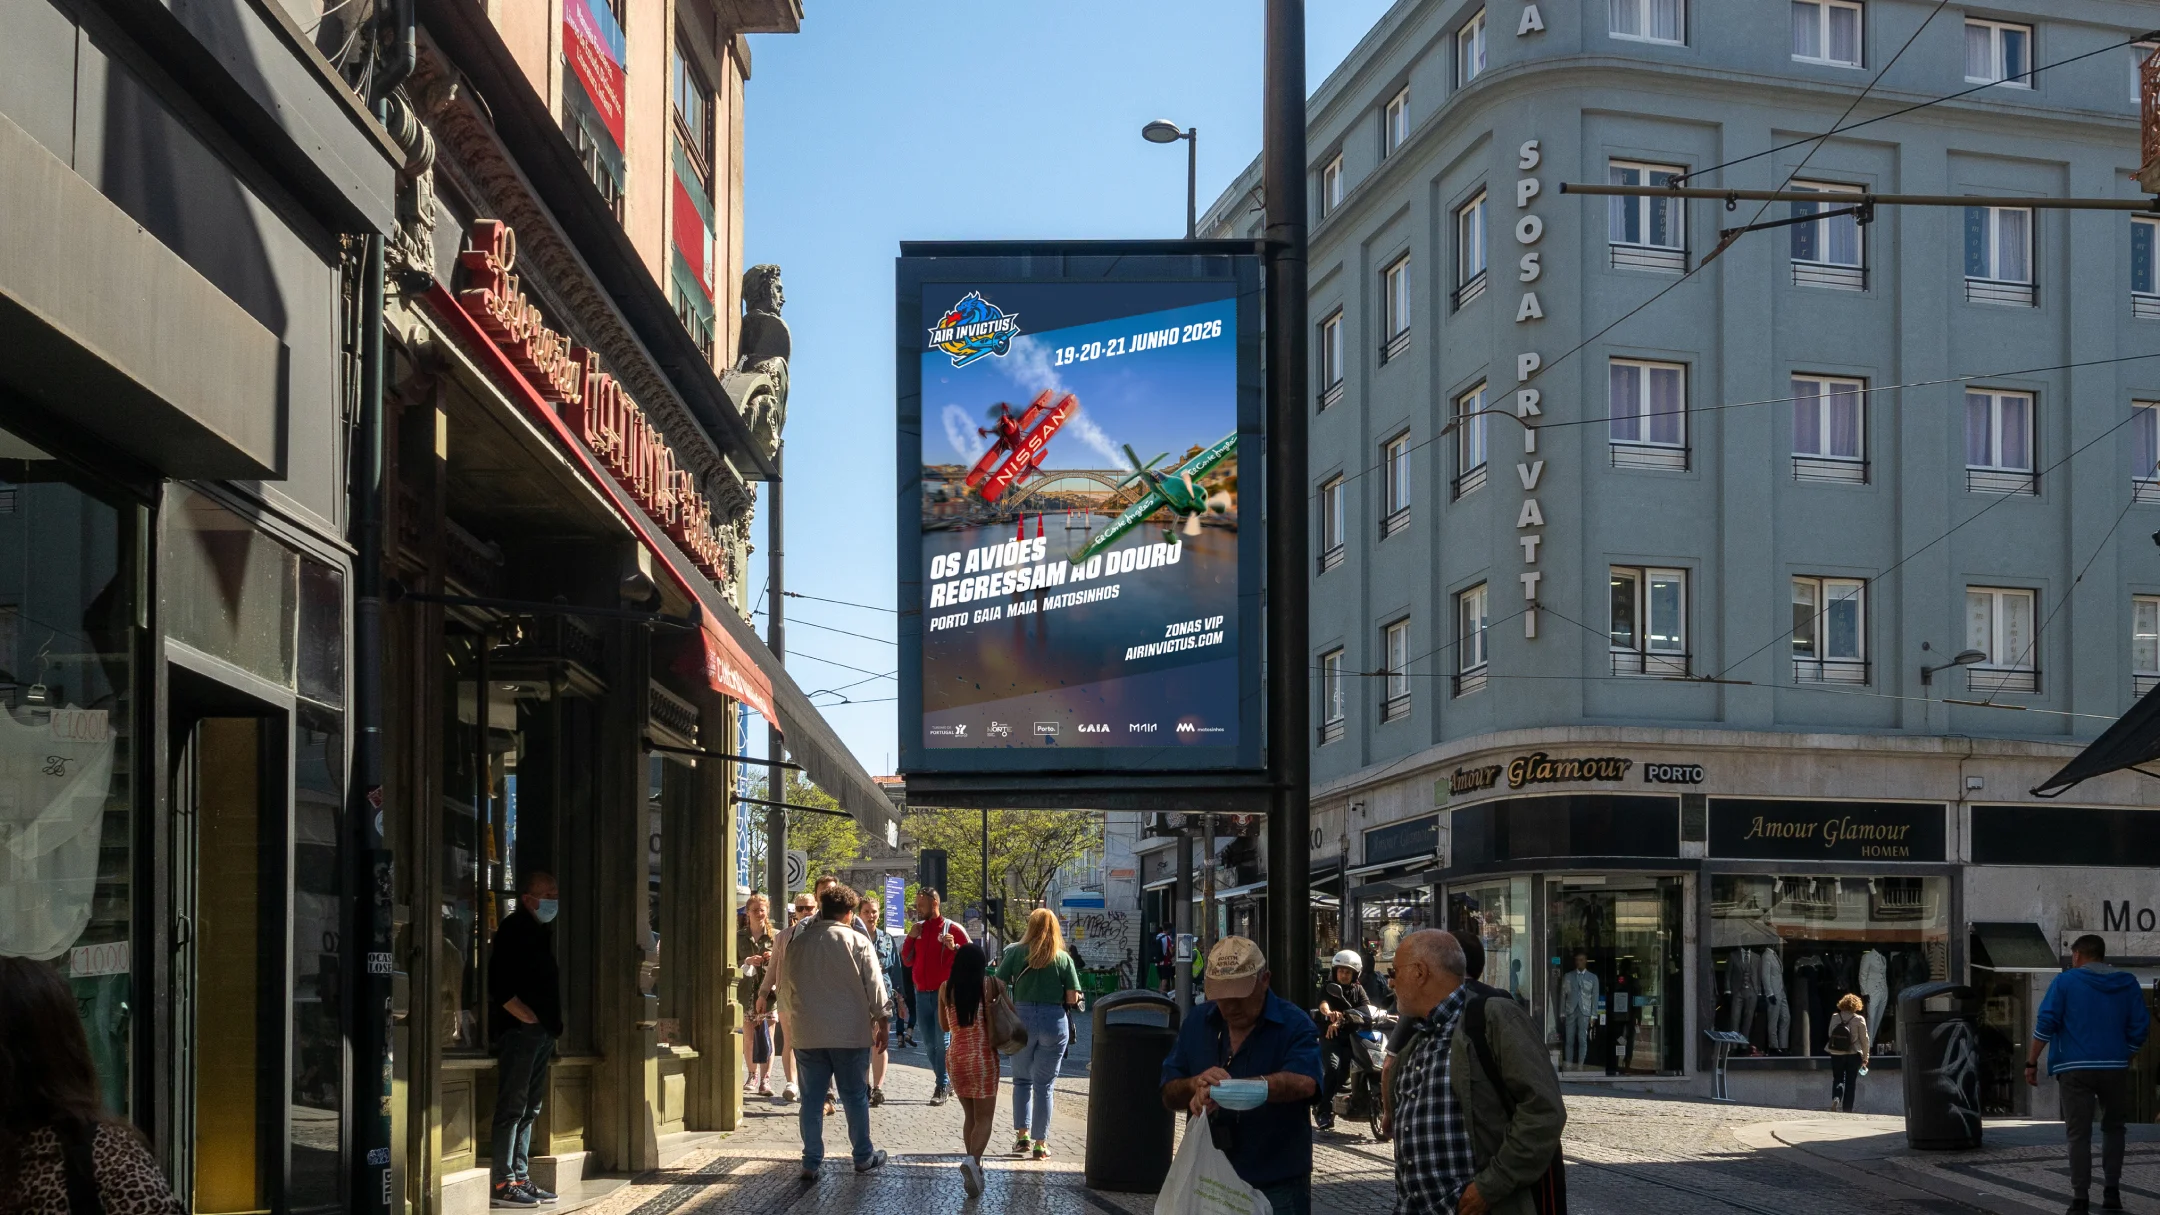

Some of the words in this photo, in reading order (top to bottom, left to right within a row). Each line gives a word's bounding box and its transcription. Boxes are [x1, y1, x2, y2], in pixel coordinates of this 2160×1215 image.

[1516, 140, 1543, 322] SPOSA
[933, 328, 954, 343] AIR
[955, 318, 1011, 338] INVICTUS
[1128, 326, 1180, 354] JUNHO
[1182, 319, 1222, 345] 2026
[996, 407, 1067, 487] NISSAN
[1517, 352, 1544, 639] PRIVATTI
[929, 560, 1069, 609] REGRESSAM
[1070, 553, 1102, 584] AO
[1104, 539, 1183, 578] DOURO
[930, 553, 962, 580] OS
[963, 536, 1048, 575] AVIÕES
[929, 612, 969, 632] PORTO
[973, 606, 1002, 625] GAIA
[1006, 599, 1038, 619] MAIA
[1042, 584, 1121, 612] MATOSINHOS
[1165, 618, 1203, 638] ZONAS
[1204, 615, 1224, 632] VIP
[1124, 630, 1224, 661] AIRINVICTUS.COM
[1077, 723, 1111, 733] GAIA
[1451, 766, 1497, 792] Amour
[1508, 755, 1632, 787] Glamour
[1648, 765, 1705, 781] PORTO
[1744, 816, 1817, 840] Amour
[1822, 816, 1910, 848] Glamour
[1861, 845, 1910, 858] HOMEM
[2103, 900, 2157, 932] Mo
